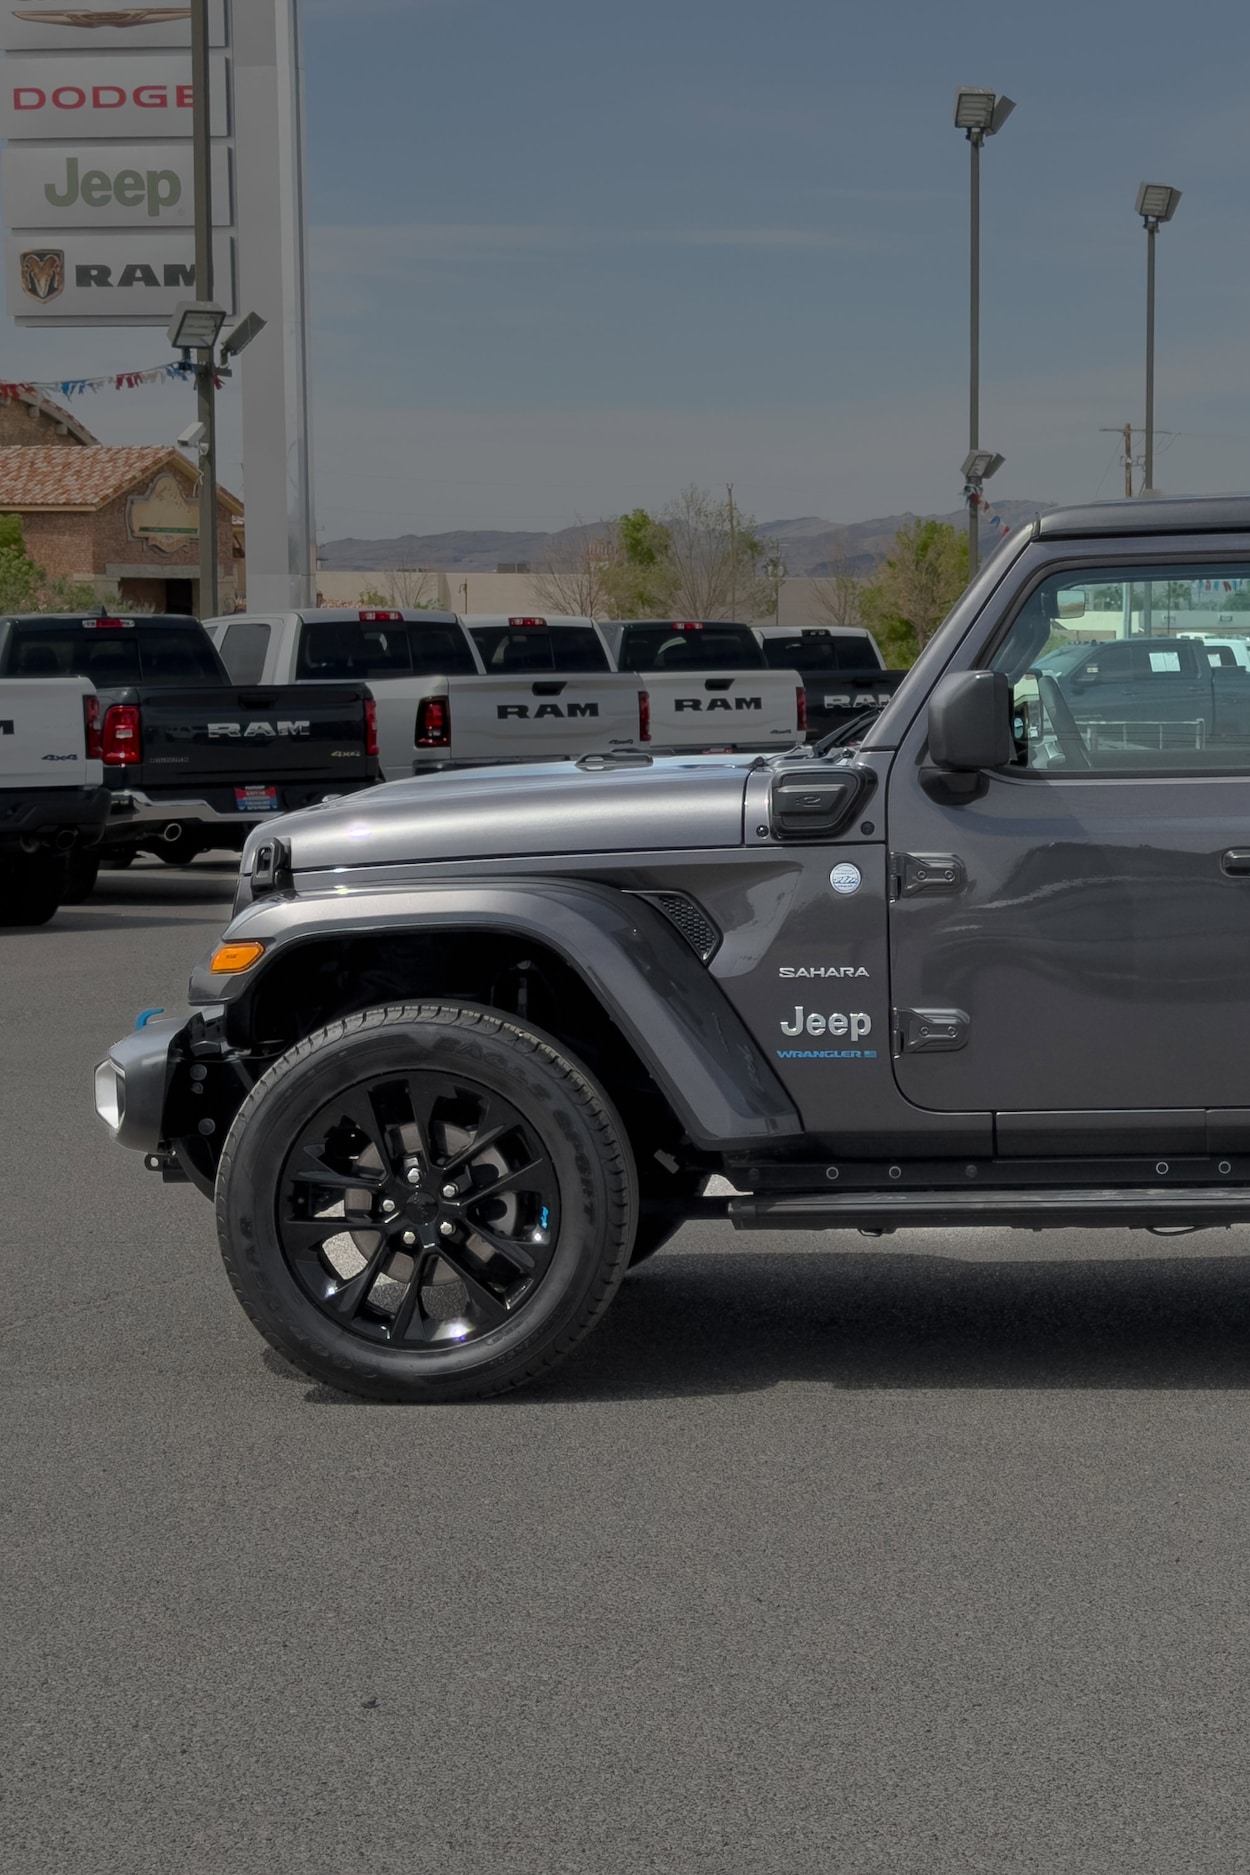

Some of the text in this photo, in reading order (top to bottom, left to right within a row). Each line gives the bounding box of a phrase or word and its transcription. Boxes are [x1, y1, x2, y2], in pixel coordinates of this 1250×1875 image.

[13, 84, 194, 111] DODGE
[44, 156, 182, 217] Jeep
[75, 263, 197, 288] RAM
[496, 702, 599, 719] RAM
[674, 697, 762, 712] RAM
[207, 720, 310, 738] RAM
[778, 966, 870, 978] SAHARA
[780, 1006, 872, 1041] Jeep
[776, 1050, 862, 1058] WRANGLER
